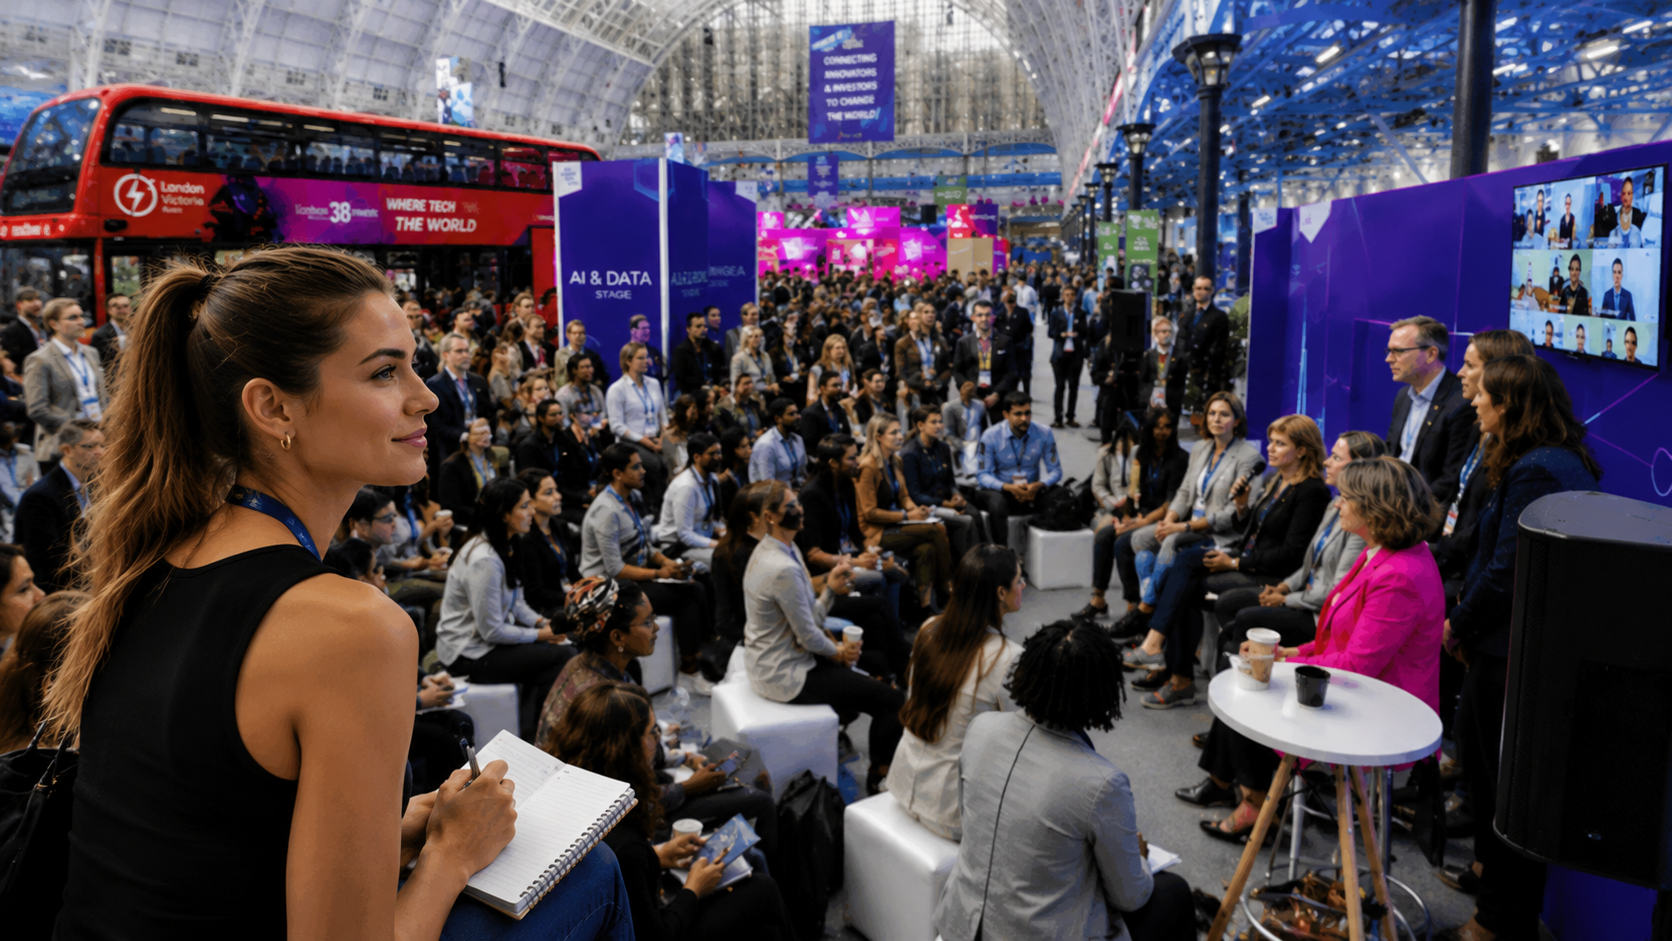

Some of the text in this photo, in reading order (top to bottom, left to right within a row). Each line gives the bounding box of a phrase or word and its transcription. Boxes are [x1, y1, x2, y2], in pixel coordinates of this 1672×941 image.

[823, 53, 877, 65] CONNECTING
[826, 98, 838, 107] TO
[160, 181, 205, 194] London
[329, 201, 351, 223] 38
[386, 198, 427, 212] WHERE
[428, 200, 456, 213] TECH
[395, 216, 477, 232] THE WORLD
[569, 270, 653, 286] AI & DATA
[595, 290, 632, 299] STAGE
